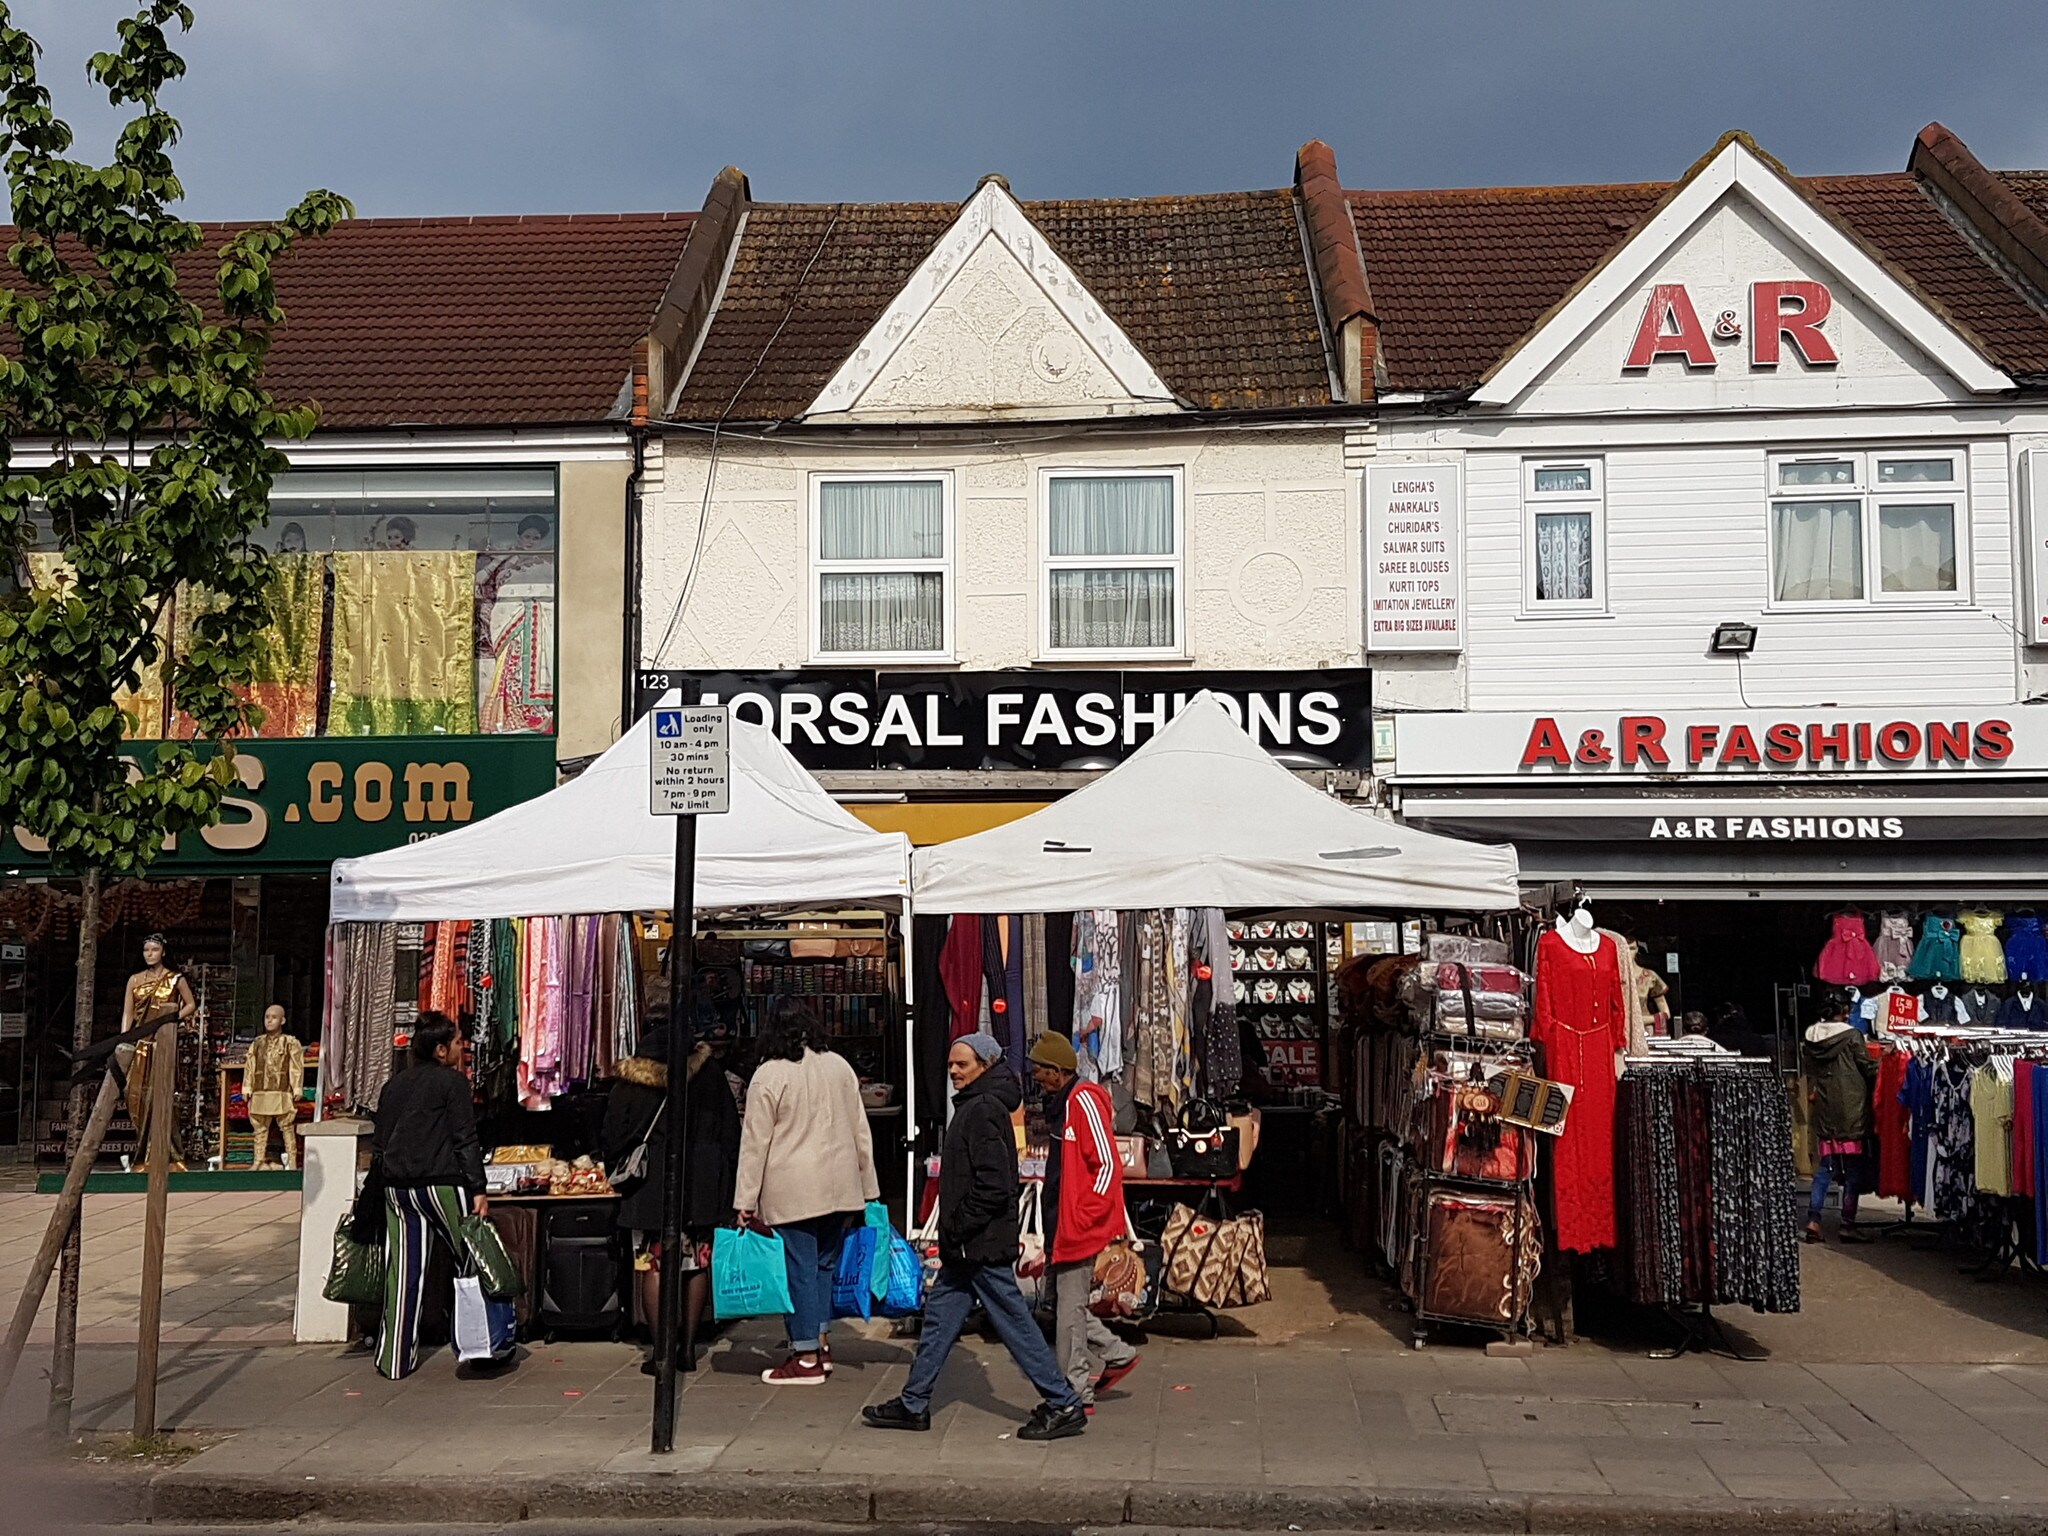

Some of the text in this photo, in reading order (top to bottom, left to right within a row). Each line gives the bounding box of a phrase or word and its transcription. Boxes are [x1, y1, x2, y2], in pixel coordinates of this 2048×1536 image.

[1392, 481, 1435, 494] LENGHA'S
[1388, 501, 1440, 514] ANARKALI'S
[1387, 521, 1440, 534] CHURIDAR'S
[1383, 541, 1445, 554] SALWAR SUITS
[1379, 561, 1450, 574] SAREE BLOUSES
[1389, 580, 1440, 593] KURTI TOPS
[1373, 598, 1456, 611] IMITATION JEWELLERY
[1373, 618, 1456, 632] EXTRA BIG SIZES AVAILABLE
[640, 674, 670, 690] 123
[684, 714, 723, 723] Loading
[700, 692, 964, 746] ORSAL
[693, 725, 714, 734] only
[660, 740, 672, 749] 10
[695, 740, 702, 748] 4
[703, 741, 719, 750] pm
[1521, 716, 2016, 766] A&R FASHIONS
[670, 752, 710, 762] 30 mins
[666, 767, 680, 775] No
[654, 776, 725, 786] within 2 hours
[693, 789, 700, 797] 9
[701, 790, 716, 799] pm
[670, 800, 710, 810] No limit
[1649, 817, 1904, 839] A&R FASHIONS
